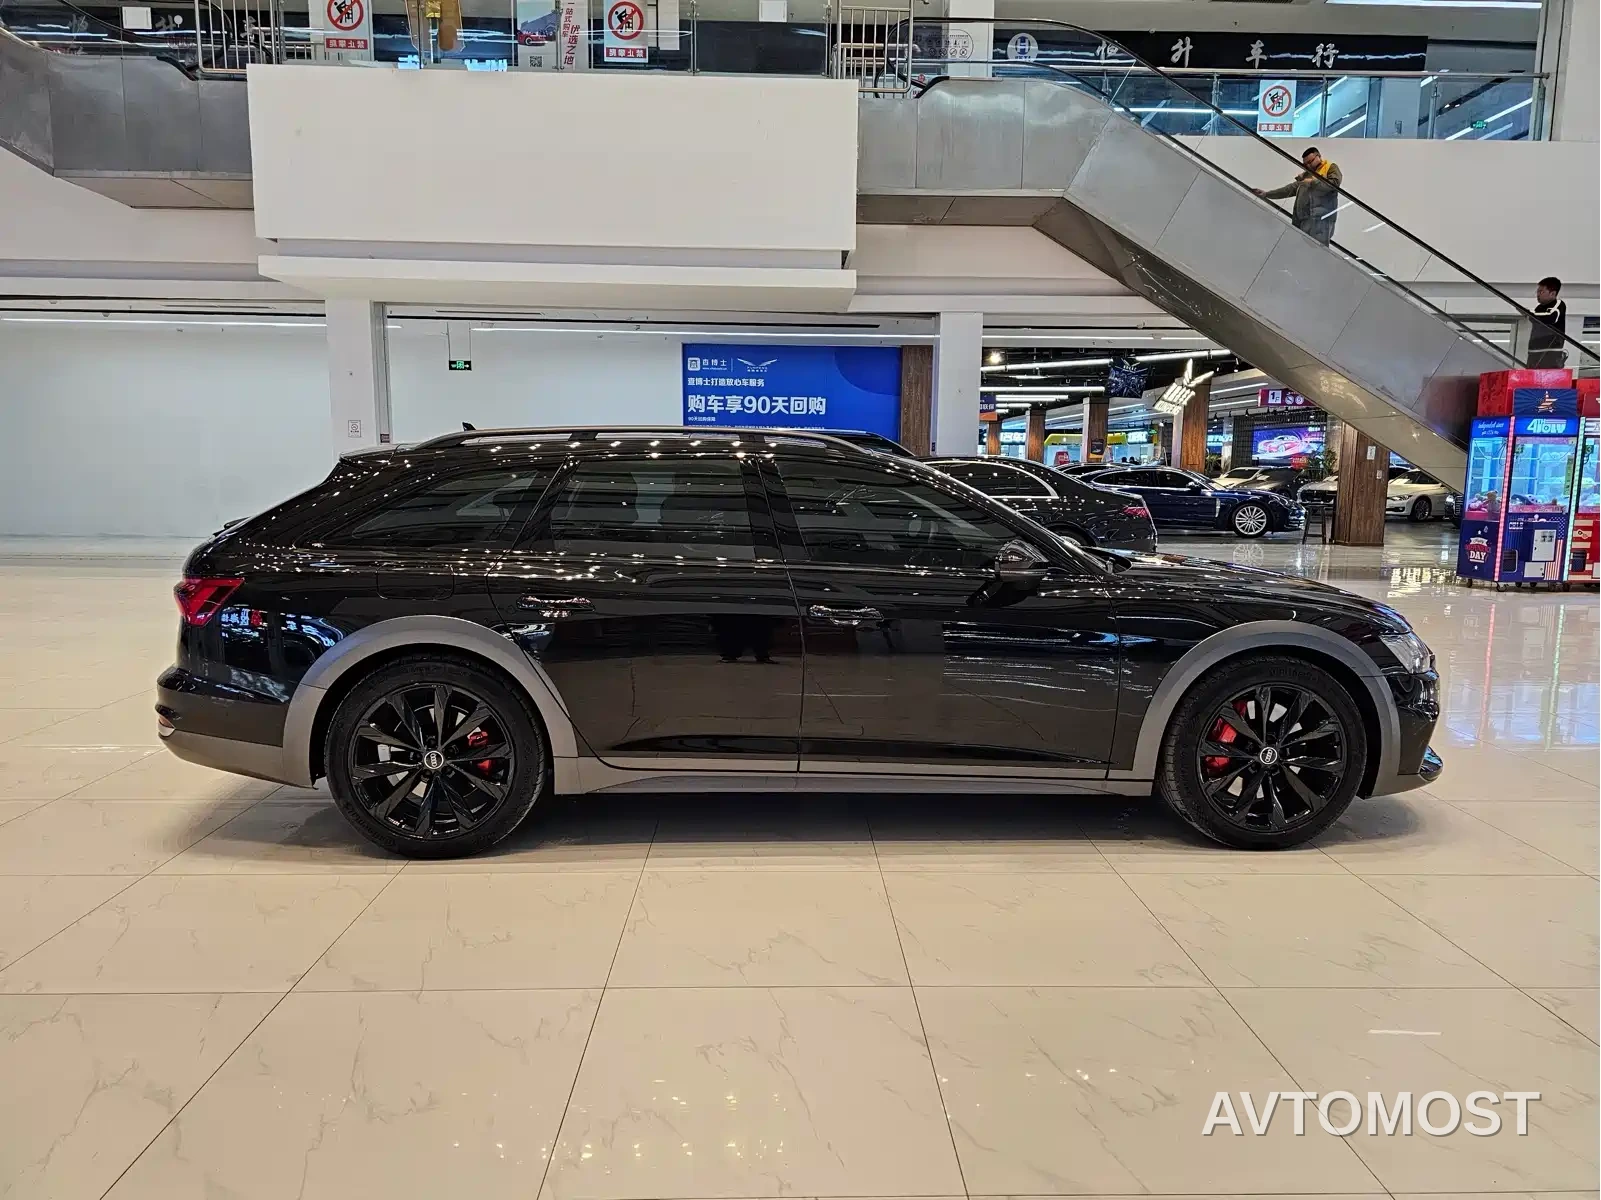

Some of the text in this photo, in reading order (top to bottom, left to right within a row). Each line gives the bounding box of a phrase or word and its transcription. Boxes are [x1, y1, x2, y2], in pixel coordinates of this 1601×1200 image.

[564, 25, 580, 65] 优选之地
[1097, 36, 1339, 69] 恒升车行
[688, 377, 765, 387] 查博士打造放心车服务
[688, 395, 826, 415] 购车享90天回购
[1469, 550, 1487, 560] DAY
